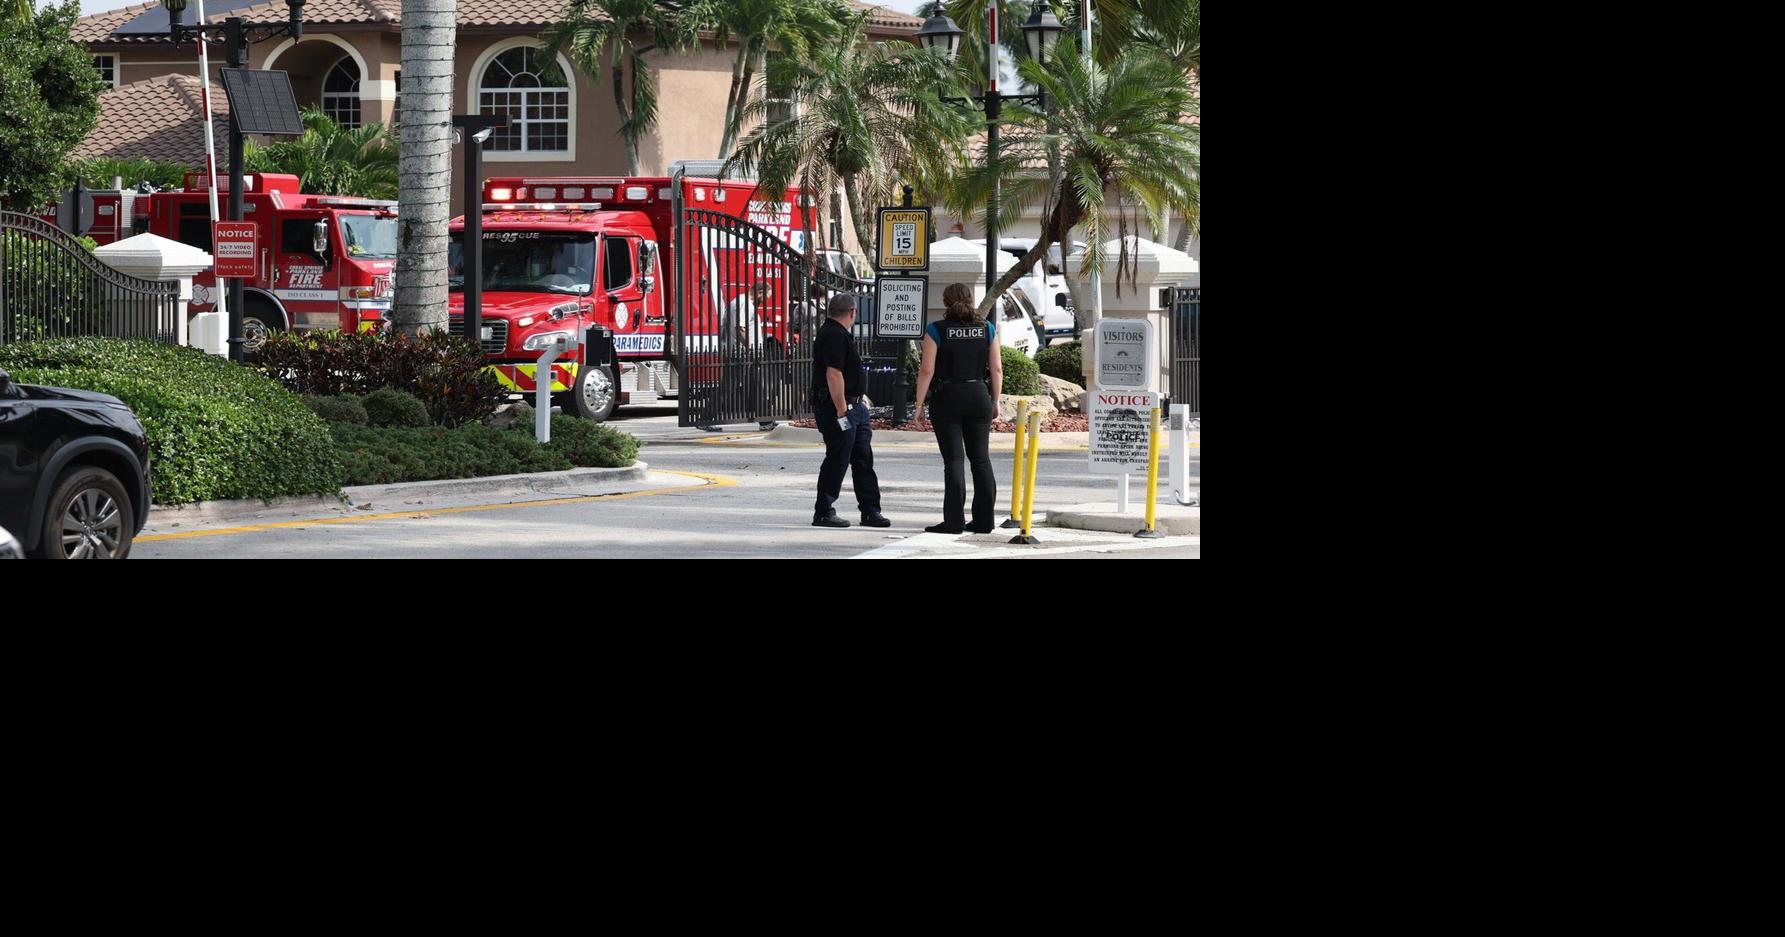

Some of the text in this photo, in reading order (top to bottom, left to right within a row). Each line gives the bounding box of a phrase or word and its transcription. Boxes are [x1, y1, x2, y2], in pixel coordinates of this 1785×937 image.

[885, 214, 924, 222] CAUTION
[896, 238, 912, 248] 15
[884, 257, 922, 265] CHILDREN
[289, 274, 324, 284] FIRE
[882, 284, 922, 292] SOLICITING
[886, 304, 916, 312] POSTING
[949, 328, 983, 338] POLICE
[1104, 331, 1144, 342] VISITORS
[1102, 364, 1142, 372] RESIDENTS
[1098, 394, 1150, 406] NOTICE
[1106, 432, 1140, 442] POLICE
